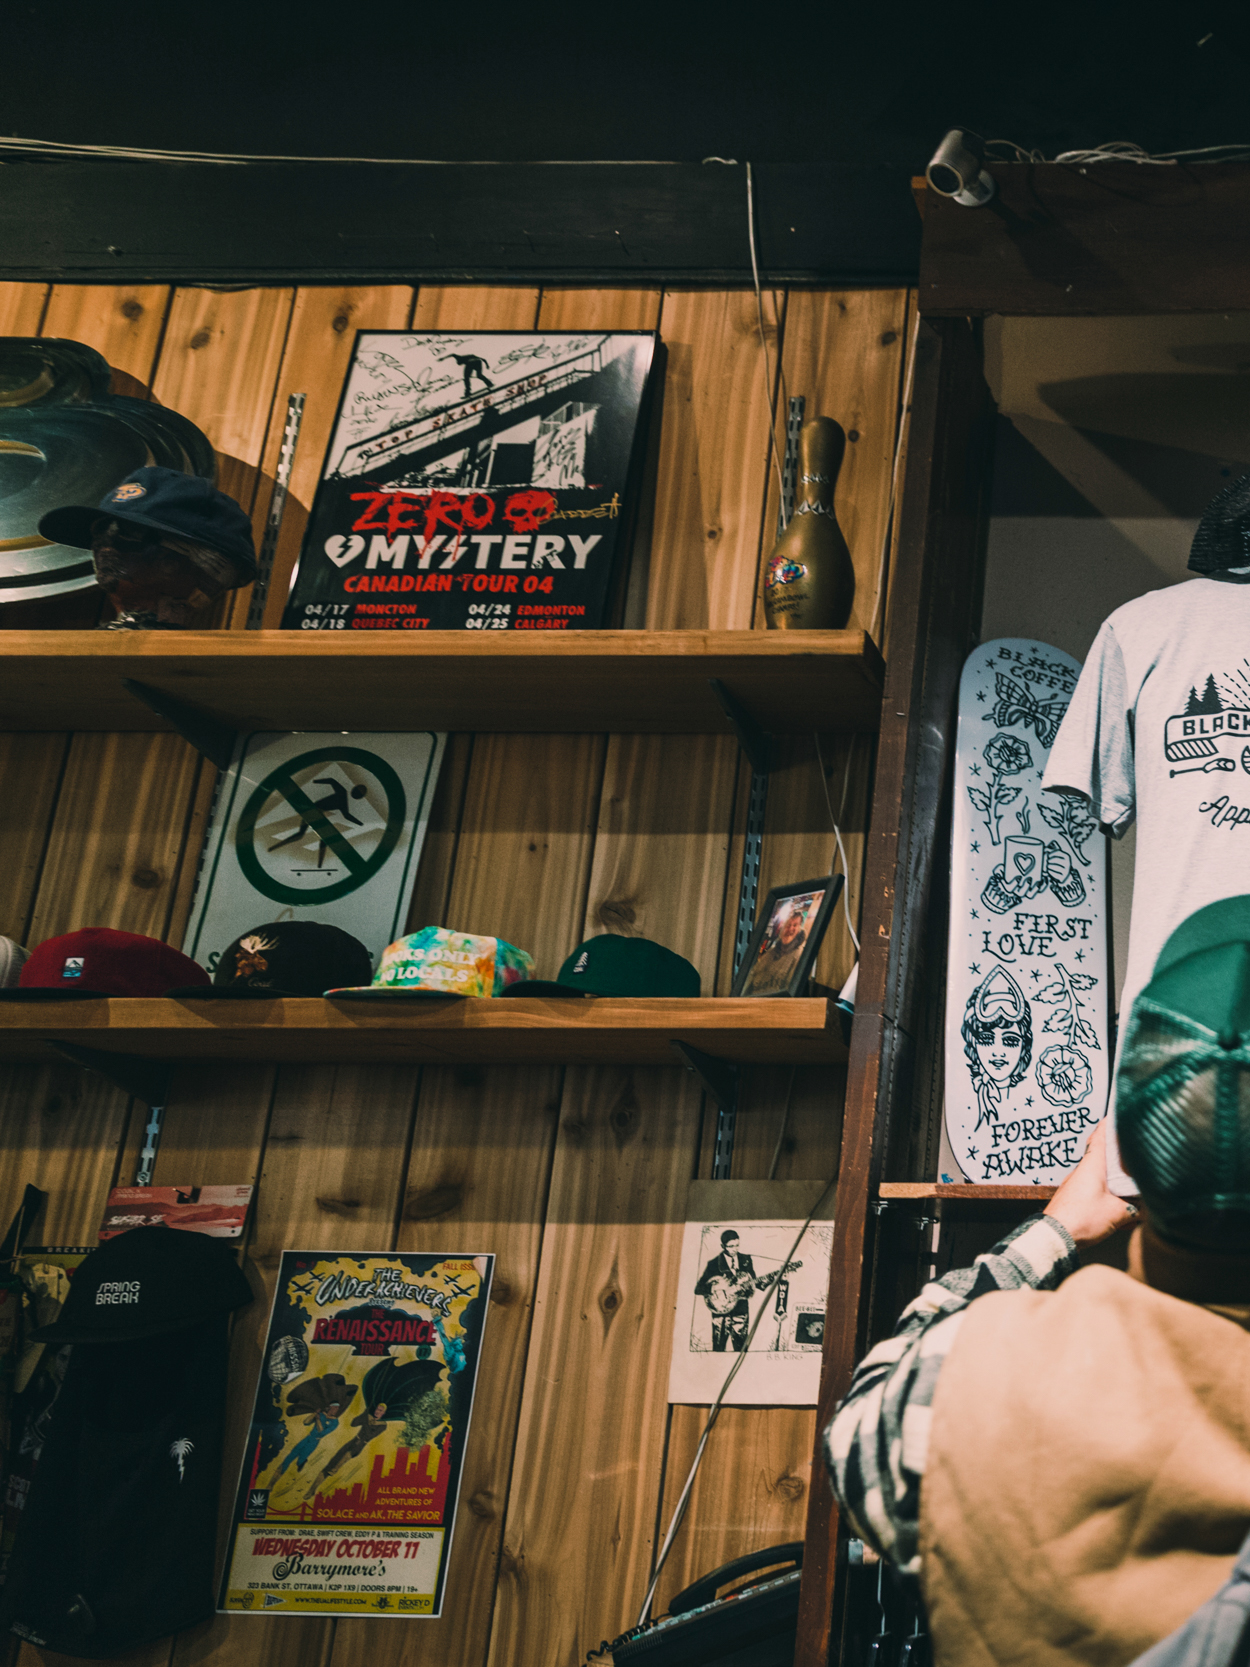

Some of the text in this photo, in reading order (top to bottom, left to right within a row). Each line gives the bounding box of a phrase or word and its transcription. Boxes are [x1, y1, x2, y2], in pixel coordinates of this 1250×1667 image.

[350, 488, 496, 543] ZERO
[365, 534, 602, 569] MYSTERY
[343, 573, 554, 594] CANADIAN TOUR 04
[304, 603, 418, 616] 04/17 MONCTON
[467, 603, 586, 616] 04/24 EDMONTON
[301, 617, 430, 630] 04/18 QUEBEC CITY
[464, 618, 570, 630] 04/25 CALGARY
[997, 646, 1079, 681] BLACK
[1010, 664, 1075, 694] COFFEE
[1013, 912, 1093, 942] FIRST
[981, 930, 1057, 963] LOVE
[428, 948, 481, 966] ONLY
[396, 965, 469, 983] LOCALS
[991, 1106, 1100, 1148] FOREVER
[981, 1137, 1083, 1180] AWAKE
[371, 1267, 403, 1284] THE
[97, 1281, 142, 1294] SPRING
[314, 1270, 453, 1317] UNDERACHIEVERS
[95, 1292, 140, 1306] BREAK
[371, 1308, 386, 1320] THE
[313, 1318, 438, 1343] RENAISSANCE
[360, 1342, 386, 1356] TOUR
[377, 1486, 436, 1495] ALL BRAND NEW
[375, 1498, 434, 1506] ADVENTURES OF
[316, 1508, 355, 1519] SOLACE
[387, 1510, 405, 1520] THE
[406, 1510, 441, 1521] SAVIOR
[249, 1528, 278, 1536] SUPPORT
[278, 1528, 296, 1536] FROM:
[316, 1529, 334, 1537] SWIFT
[335, 1530, 353, 1538] CREW,
[355, 1530, 371, 1538] EDDY
[382, 1531, 409, 1539] TRAINING
[410, 1531, 435, 1539] SEASON
[251, 1536, 421, 1559] WEDNESDAY OCTOBER 11
[272, 1551, 387, 1582] Barrymore's
[247, 1582, 260, 1590] 323
[260, 1582, 280, 1590] BANK
[293, 1583, 324, 1591] OTTAWA
[328, 1584, 342, 1592] K2P
[361, 1585, 386, 1593] DOORS
[386, 1585, 402, 1593] 8PM
